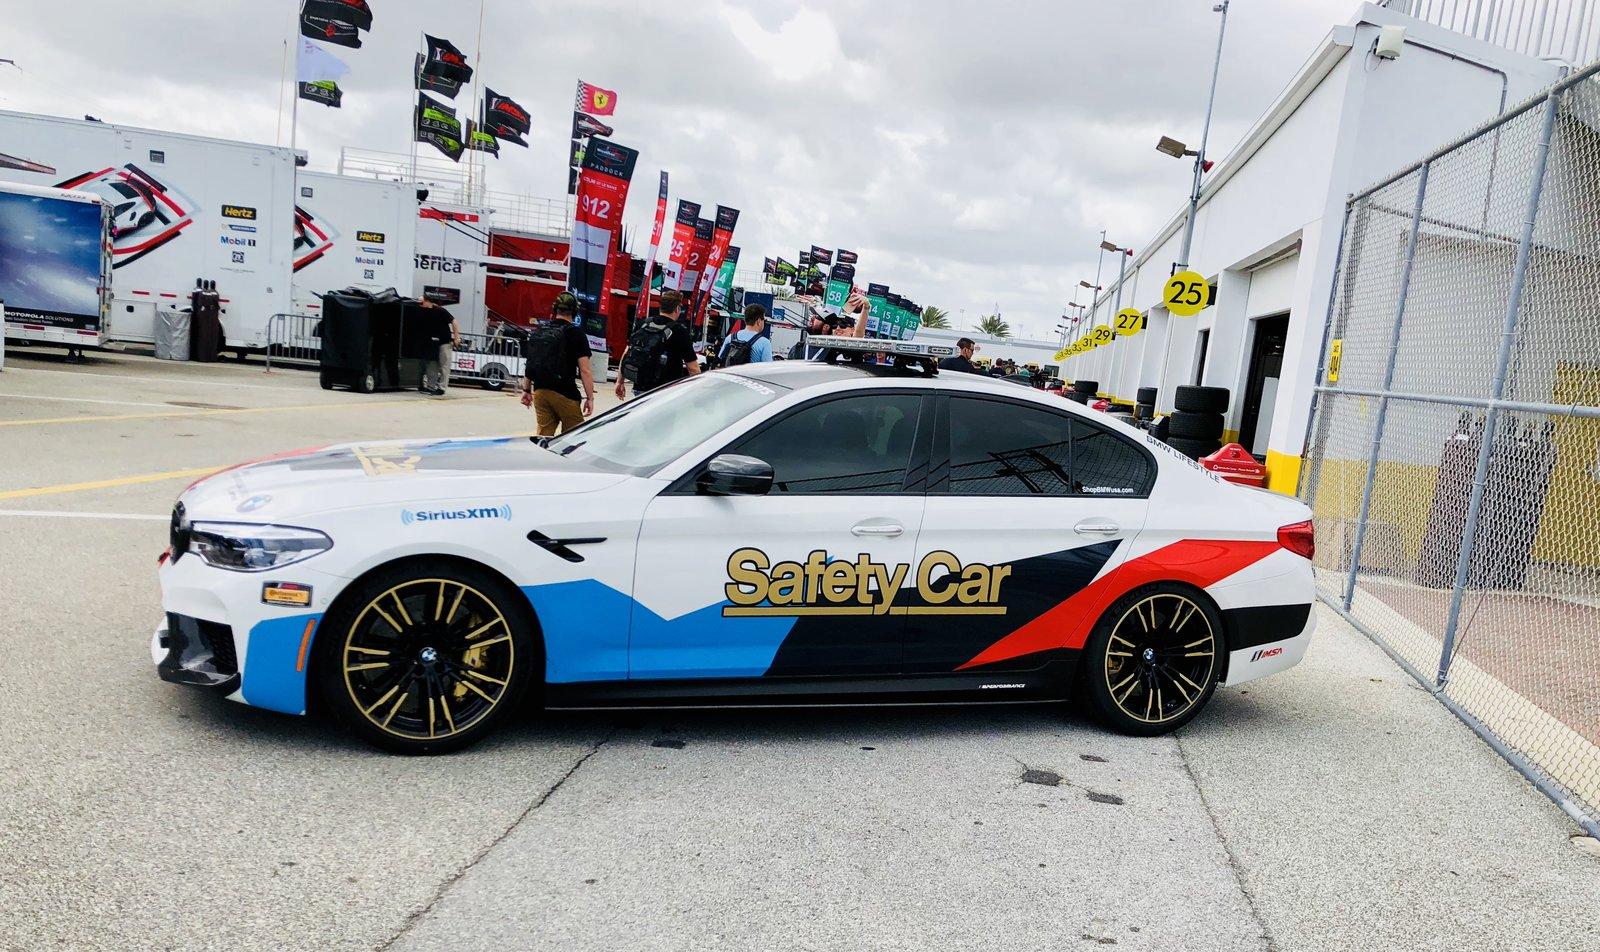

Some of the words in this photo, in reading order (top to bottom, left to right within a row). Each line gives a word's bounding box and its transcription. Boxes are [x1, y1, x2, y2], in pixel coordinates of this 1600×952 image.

[590, 162, 624, 177] PADDOCK
[224, 206, 253, 219] Hertz
[582, 193, 611, 219] 912
[220, 235, 246, 246] Mobil
[671, 238, 685, 258] 25
[708, 244, 722, 262] 24
[354, 256, 376, 265] Mobil
[688, 252, 699, 266] 2
[719, 271, 728, 284] 4
[828, 290, 842, 302] 58
[1168, 280, 1203, 306] 25
[4, 311, 44, 320] MOTOROLA
[44, 315, 74, 323] SOLUTIONS
[882, 310, 891, 320] 15
[894, 315, 900, 323] 3
[1117, 313, 1140, 330] 27
[1094, 329, 1111, 341] 29
[1082, 337, 1093, 347] 31
[1146, 434, 1171, 454] BMW
[1173, 450, 1221, 484] LIFESTYLE
[1081, 485, 1134, 495] ShopBMWusa.com
[724, 546, 910, 616] Safety
[915, 549, 1012, 605] Car
[1258, 647, 1283, 659] IMSA
